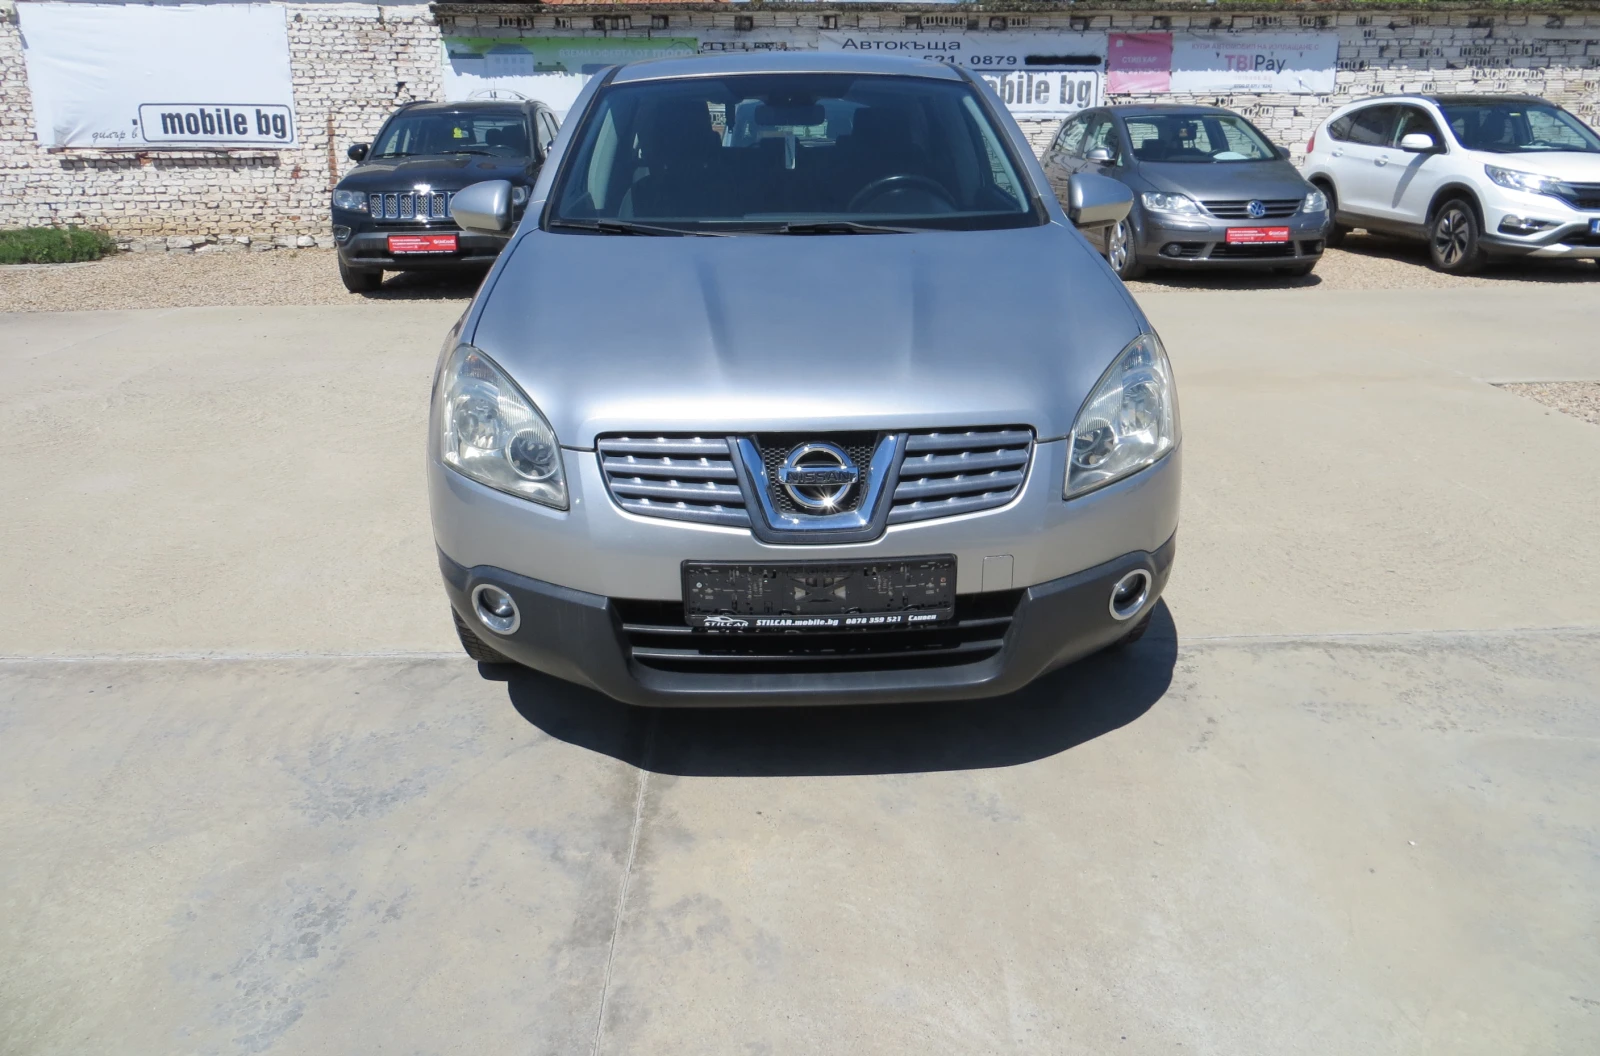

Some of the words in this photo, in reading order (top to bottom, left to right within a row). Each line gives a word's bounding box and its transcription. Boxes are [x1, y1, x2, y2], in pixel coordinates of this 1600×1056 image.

[841, 38, 961, 51] Автокъща
[970, 55, 1017, 65] 0879
[1225, 54, 1286, 75] TBIPay
[1060, 75, 1092, 108] bg
[161, 108, 249, 135] mobile
[255, 109, 287, 139] bg
[786, 470, 851, 483] NISSAN
[756, 618, 839, 626] STILCAR.mobile.bg
